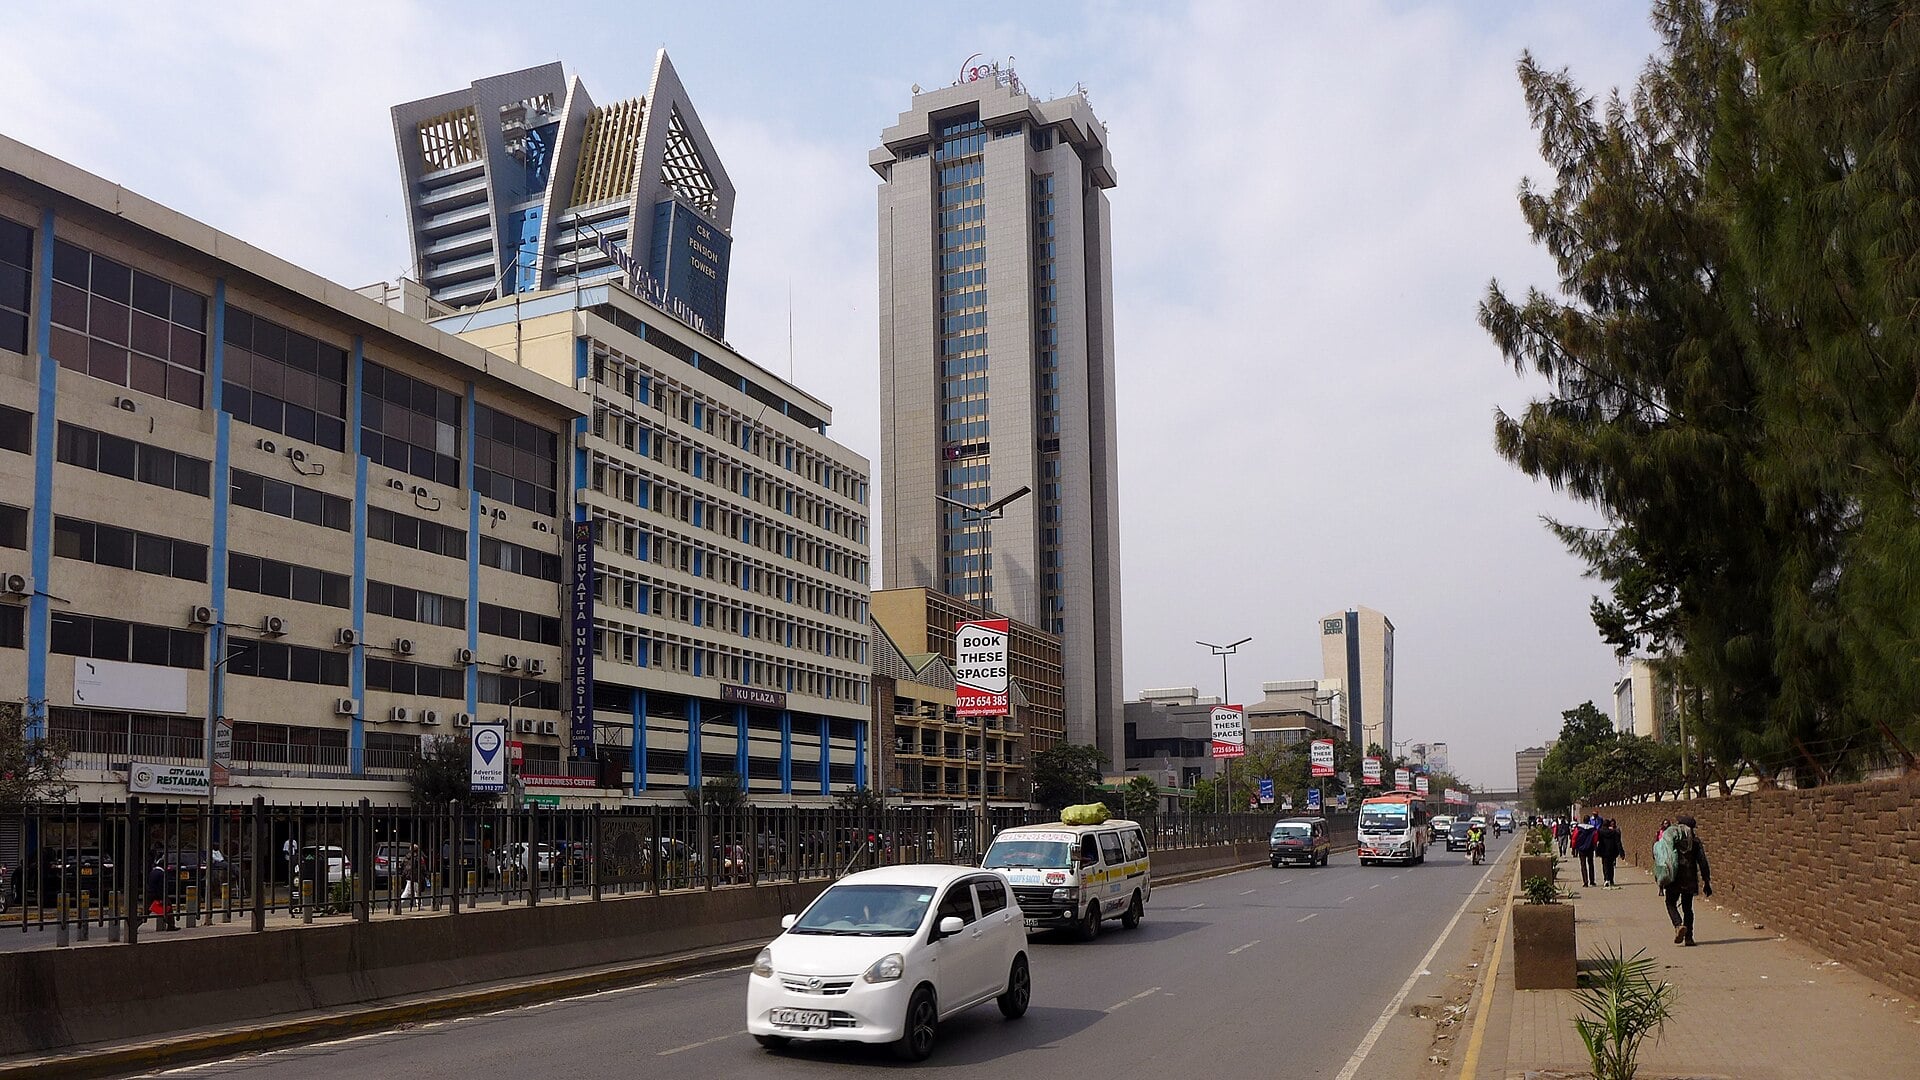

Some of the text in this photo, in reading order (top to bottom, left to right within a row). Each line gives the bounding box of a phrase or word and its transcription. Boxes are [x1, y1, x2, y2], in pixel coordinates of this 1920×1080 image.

[696, 225, 710, 240] CBK
[689, 237, 718, 263] PENSION
[690, 256, 716, 279] TOWERS
[576, 544, 587, 724] KENYATTA UNIVERSITY
[963, 636, 1000, 648] BOOK
[961, 652, 1003, 663] THESE
[957, 667, 1006, 679] SPACES
[736, 690, 775, 703] KU PLAZA
[956, 695, 1007, 707] 0725 654 385
[156, 775, 209, 787] RESTAURAN
